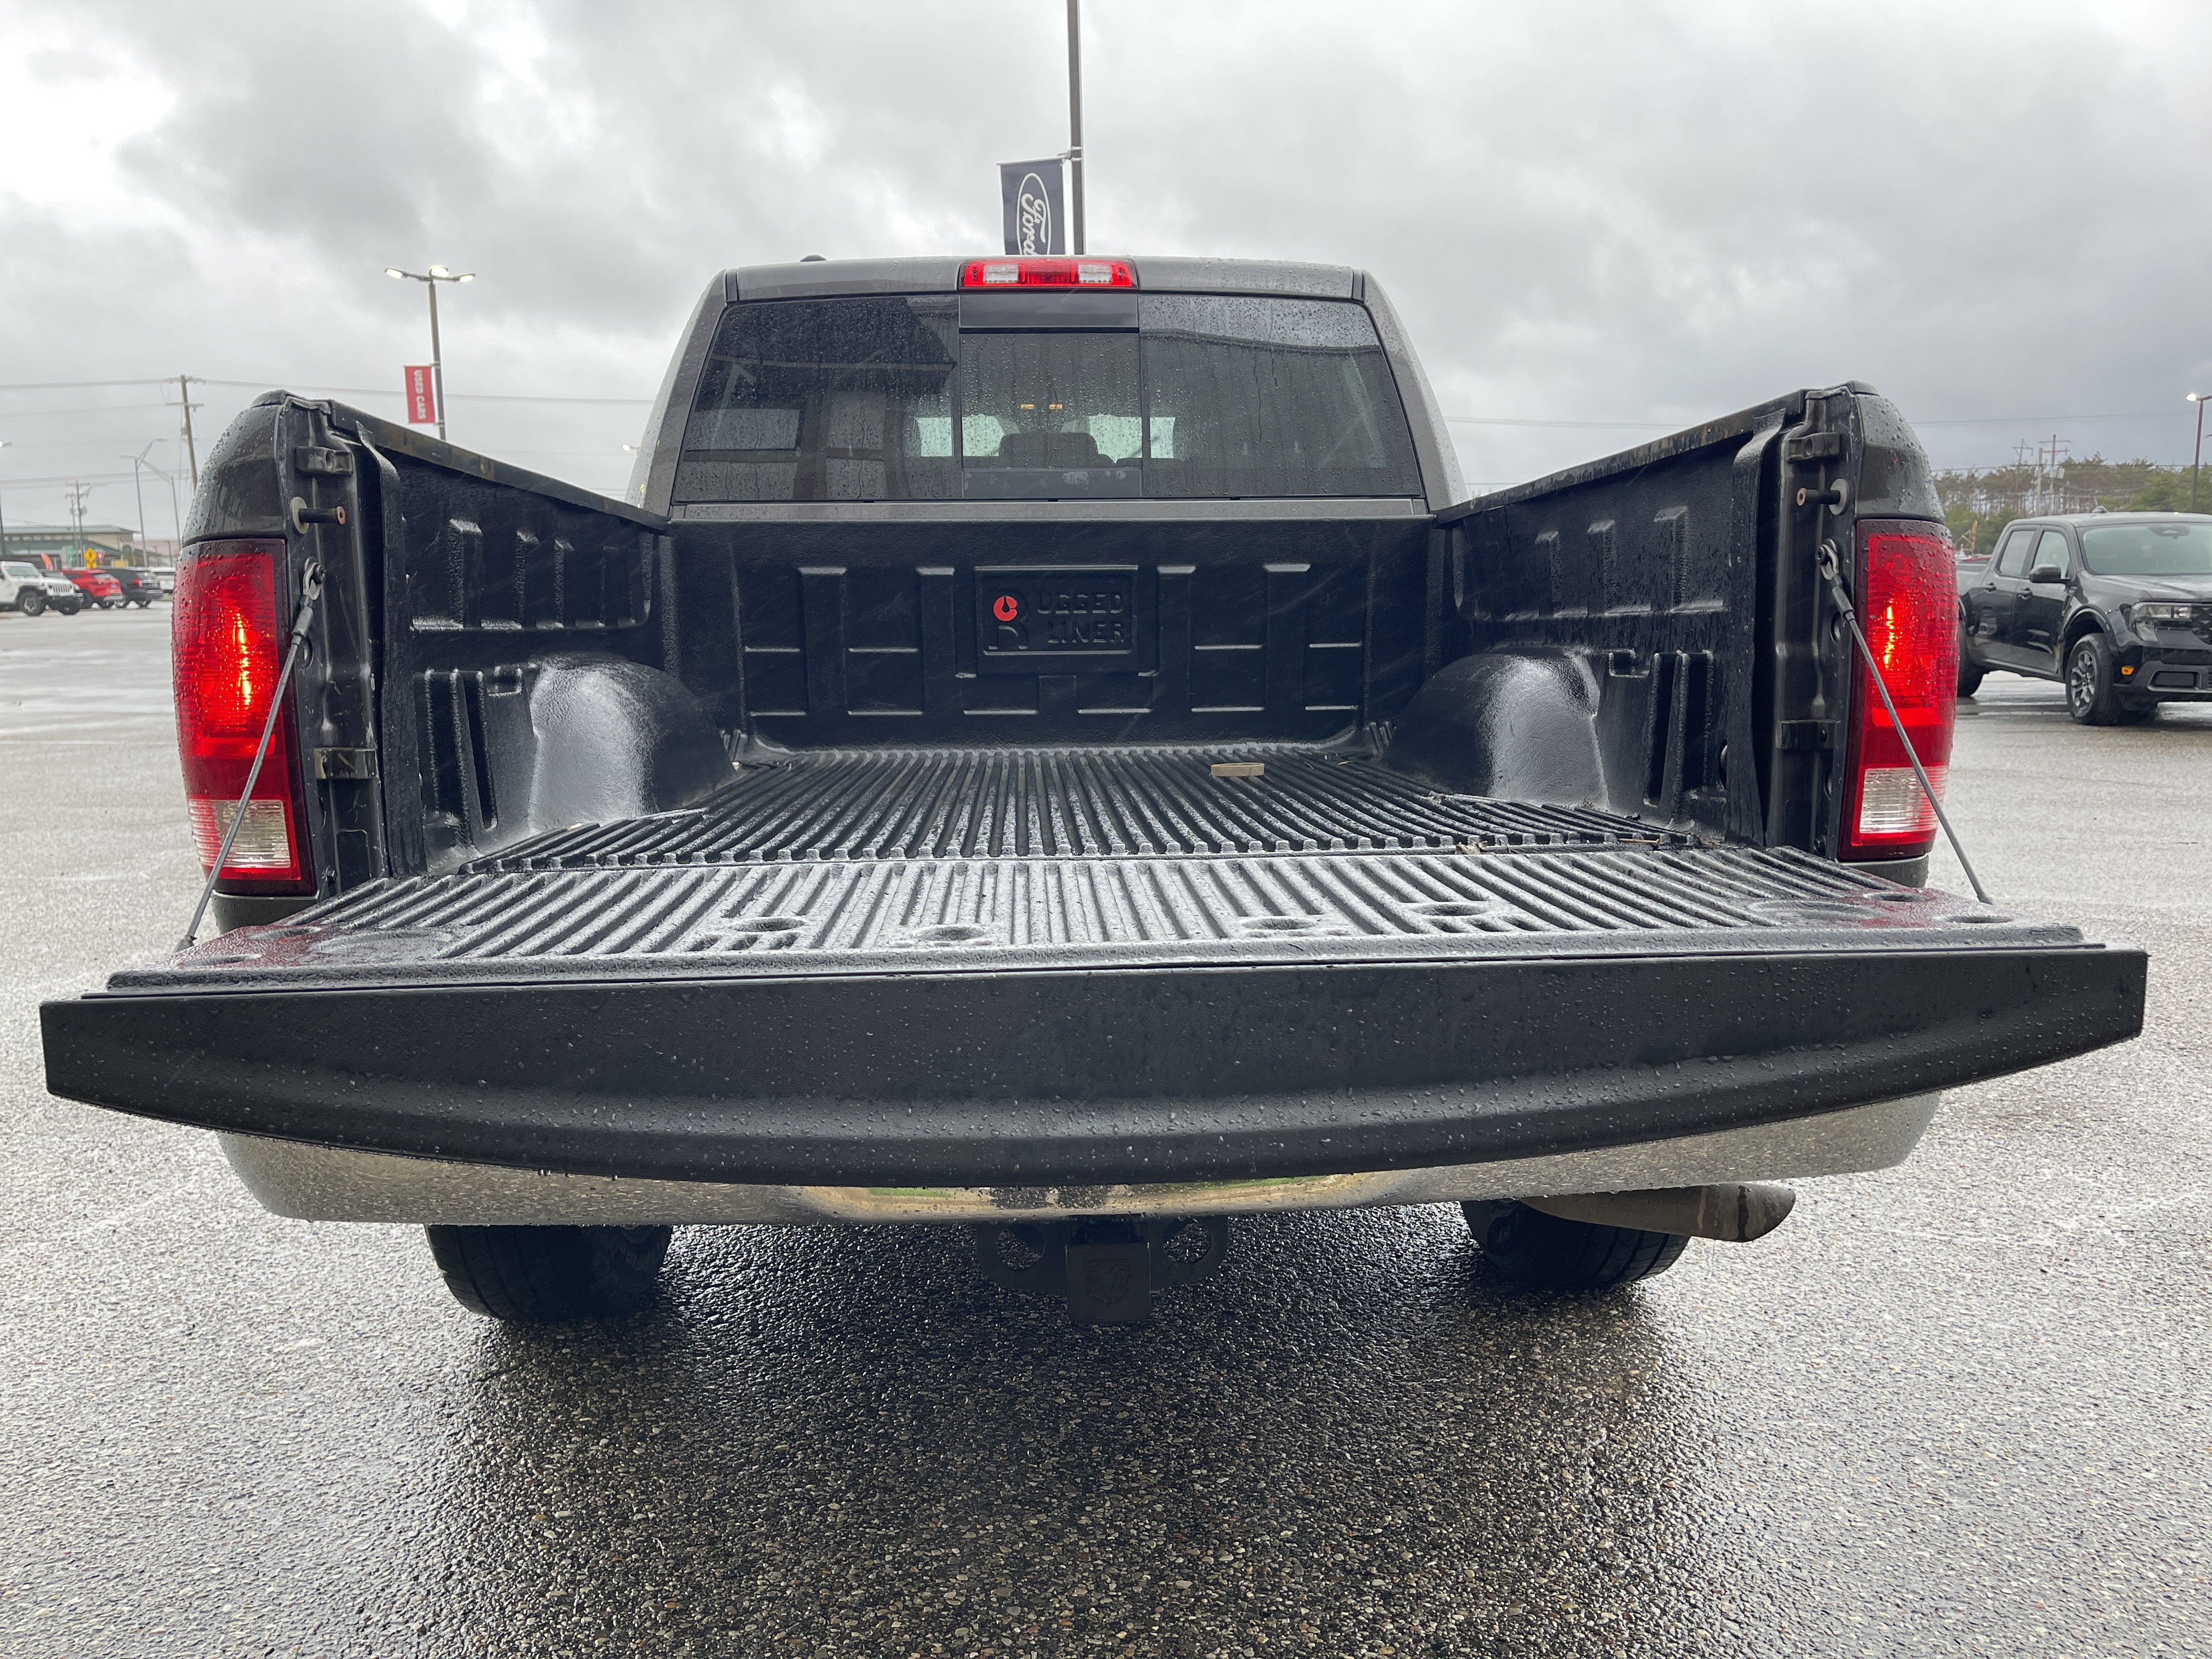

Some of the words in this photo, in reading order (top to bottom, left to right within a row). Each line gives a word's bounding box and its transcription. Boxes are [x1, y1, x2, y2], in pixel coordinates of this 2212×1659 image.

[414, 369, 424, 394] USED
[416, 395, 426, 420] CARS
[1048, 622, 1125, 644] LINER
